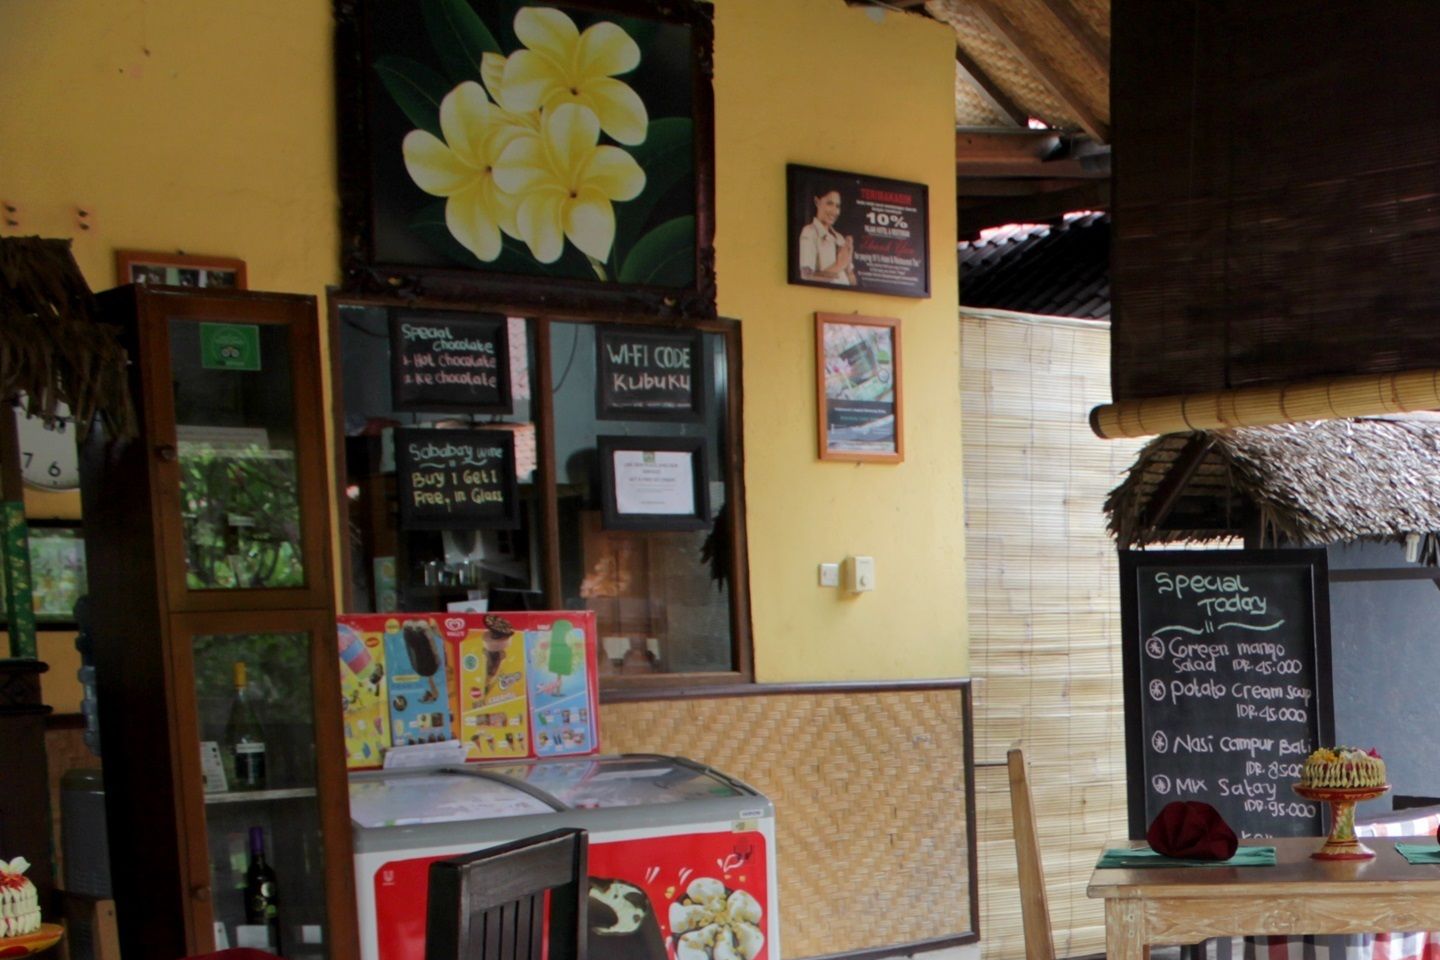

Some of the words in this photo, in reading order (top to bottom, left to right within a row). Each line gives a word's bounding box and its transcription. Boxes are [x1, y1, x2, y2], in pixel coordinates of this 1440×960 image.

[866, 212, 908, 228] 10%
[654, 346, 690, 368] CODE
[22, 452, 33, 468] 7
[48, 460, 61, 477] 6
[412, 471, 445, 488] Buy
[1154, 572, 1249, 599] Special
[1197, 593, 1267, 616] Today
[1169, 636, 1229, 660] Green
[1173, 734, 1213, 754] Nasi
[1279, 738, 1311, 756] Bali
[1218, 778, 1276, 801] Satay
